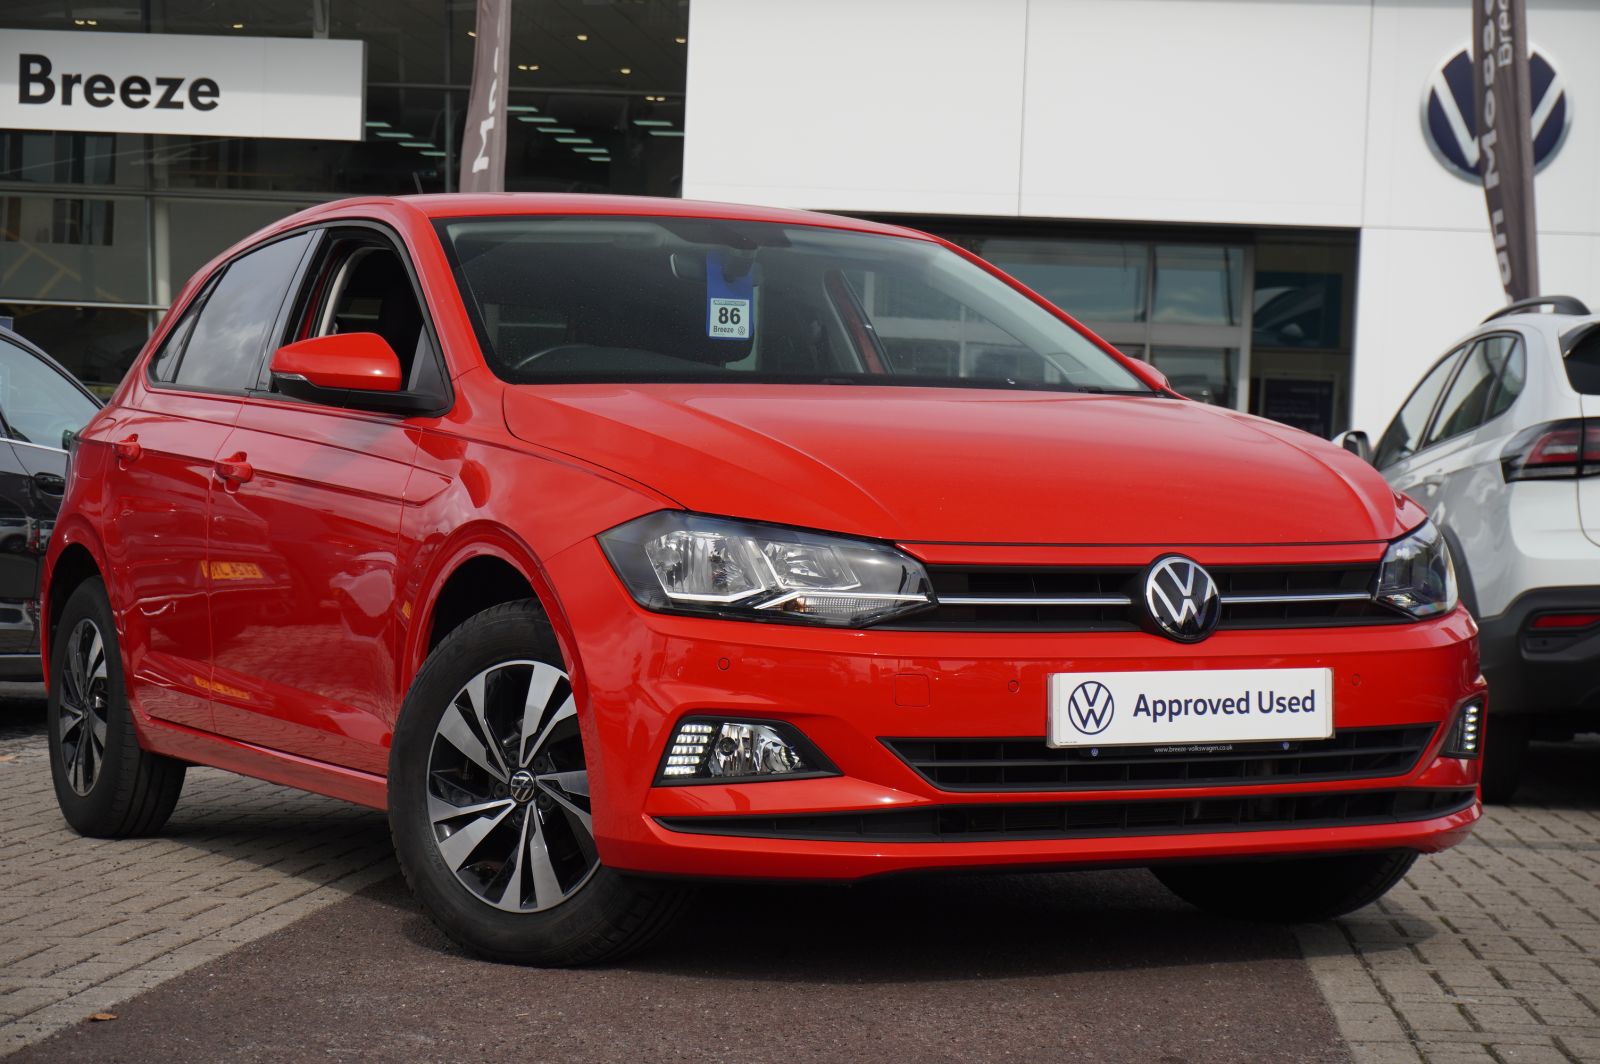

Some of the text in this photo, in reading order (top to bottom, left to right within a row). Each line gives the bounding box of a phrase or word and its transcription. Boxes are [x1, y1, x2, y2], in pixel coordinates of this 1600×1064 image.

[18, 53, 221, 112] Breeze
[718, 307, 741, 324] 86
[1133, 691, 1251, 723] Approved
[1258, 689, 1316, 714] Used
[1153, 744, 1233, 753] www.breeze-volkswagen.co.uk
